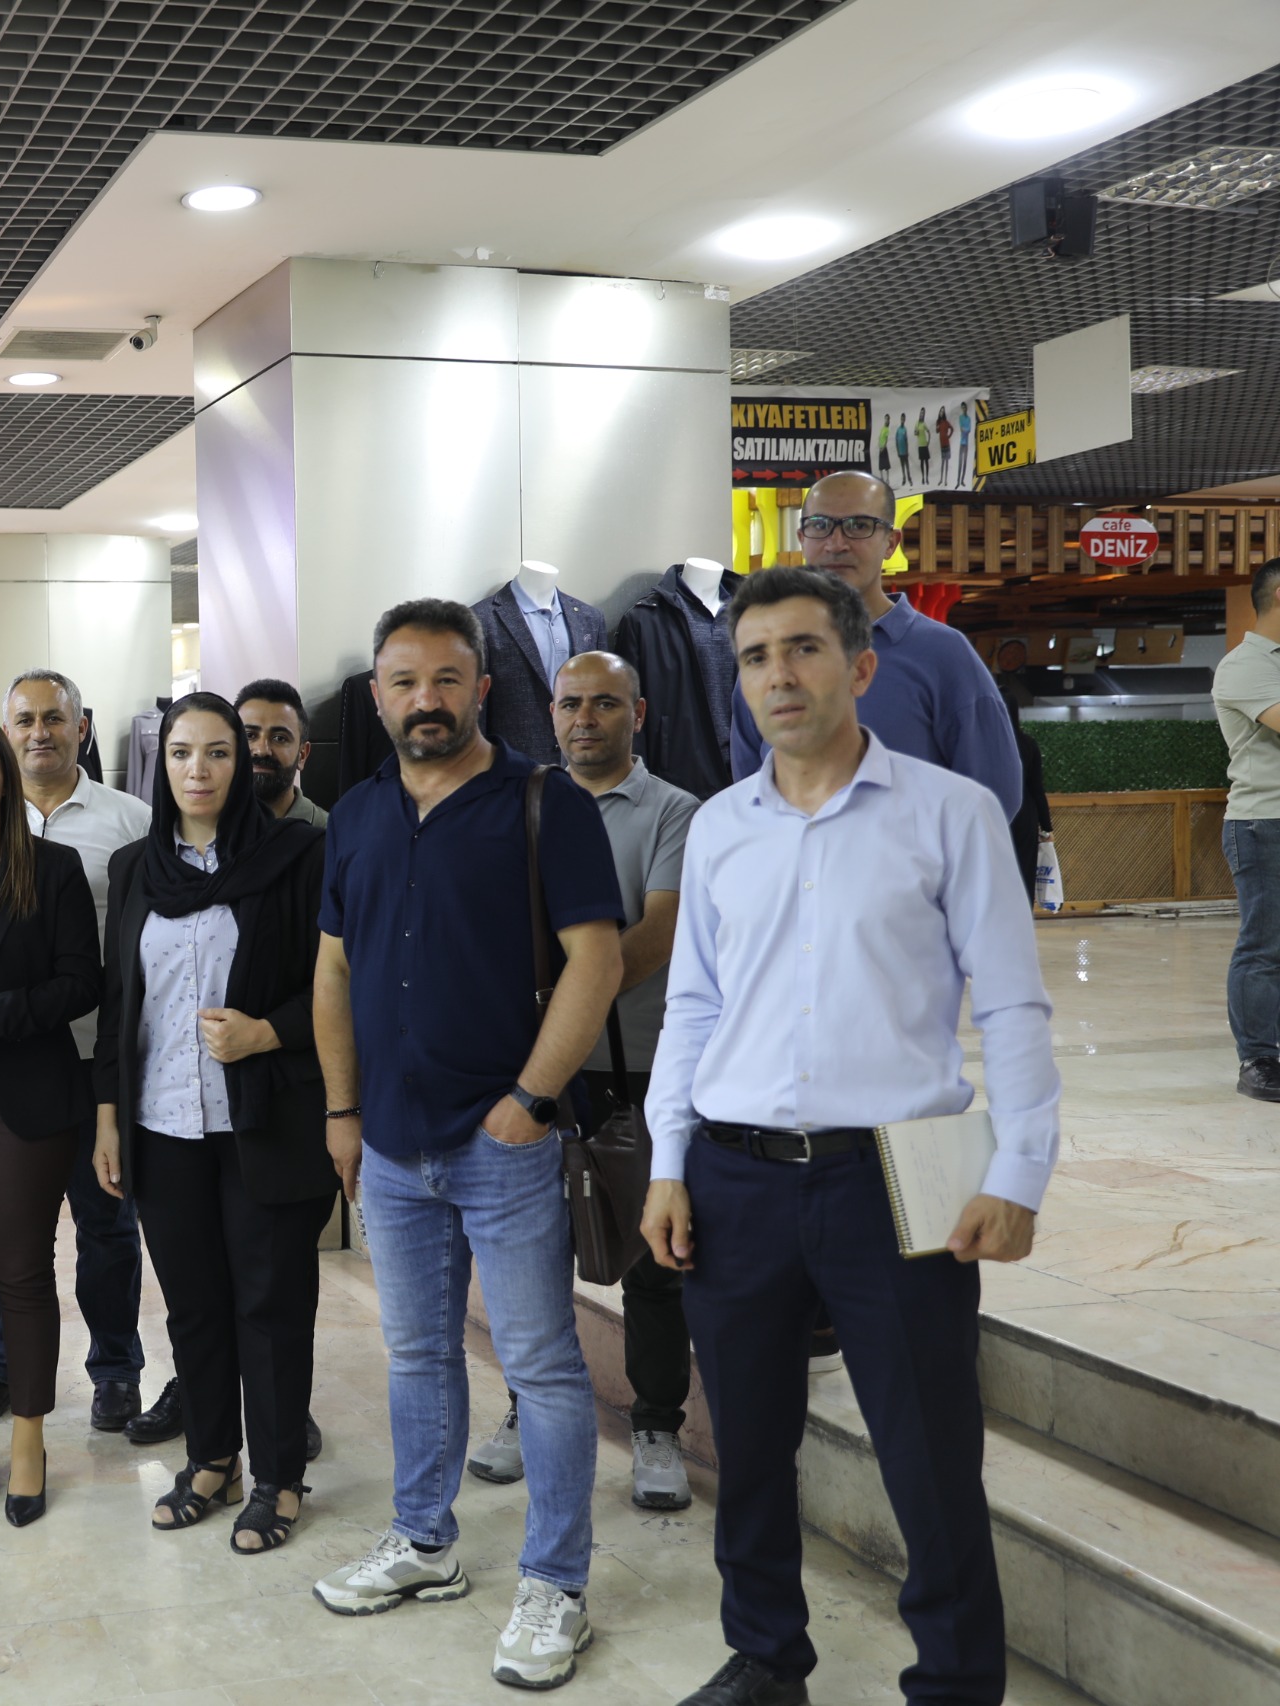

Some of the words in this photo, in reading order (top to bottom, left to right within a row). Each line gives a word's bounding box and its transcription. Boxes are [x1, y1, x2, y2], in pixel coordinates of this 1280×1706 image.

[731, 402, 867, 430] KIYAFETLERİ
[979, 427, 994, 443] BAY
[1000, 418, 1026, 439] BAYAN
[733, 436, 865, 462] SATILMAKTADIR
[988, 441, 1017, 466] WC
[1102, 518, 1131, 531] cafe
[1090, 535, 1148, 557] DENİZ
